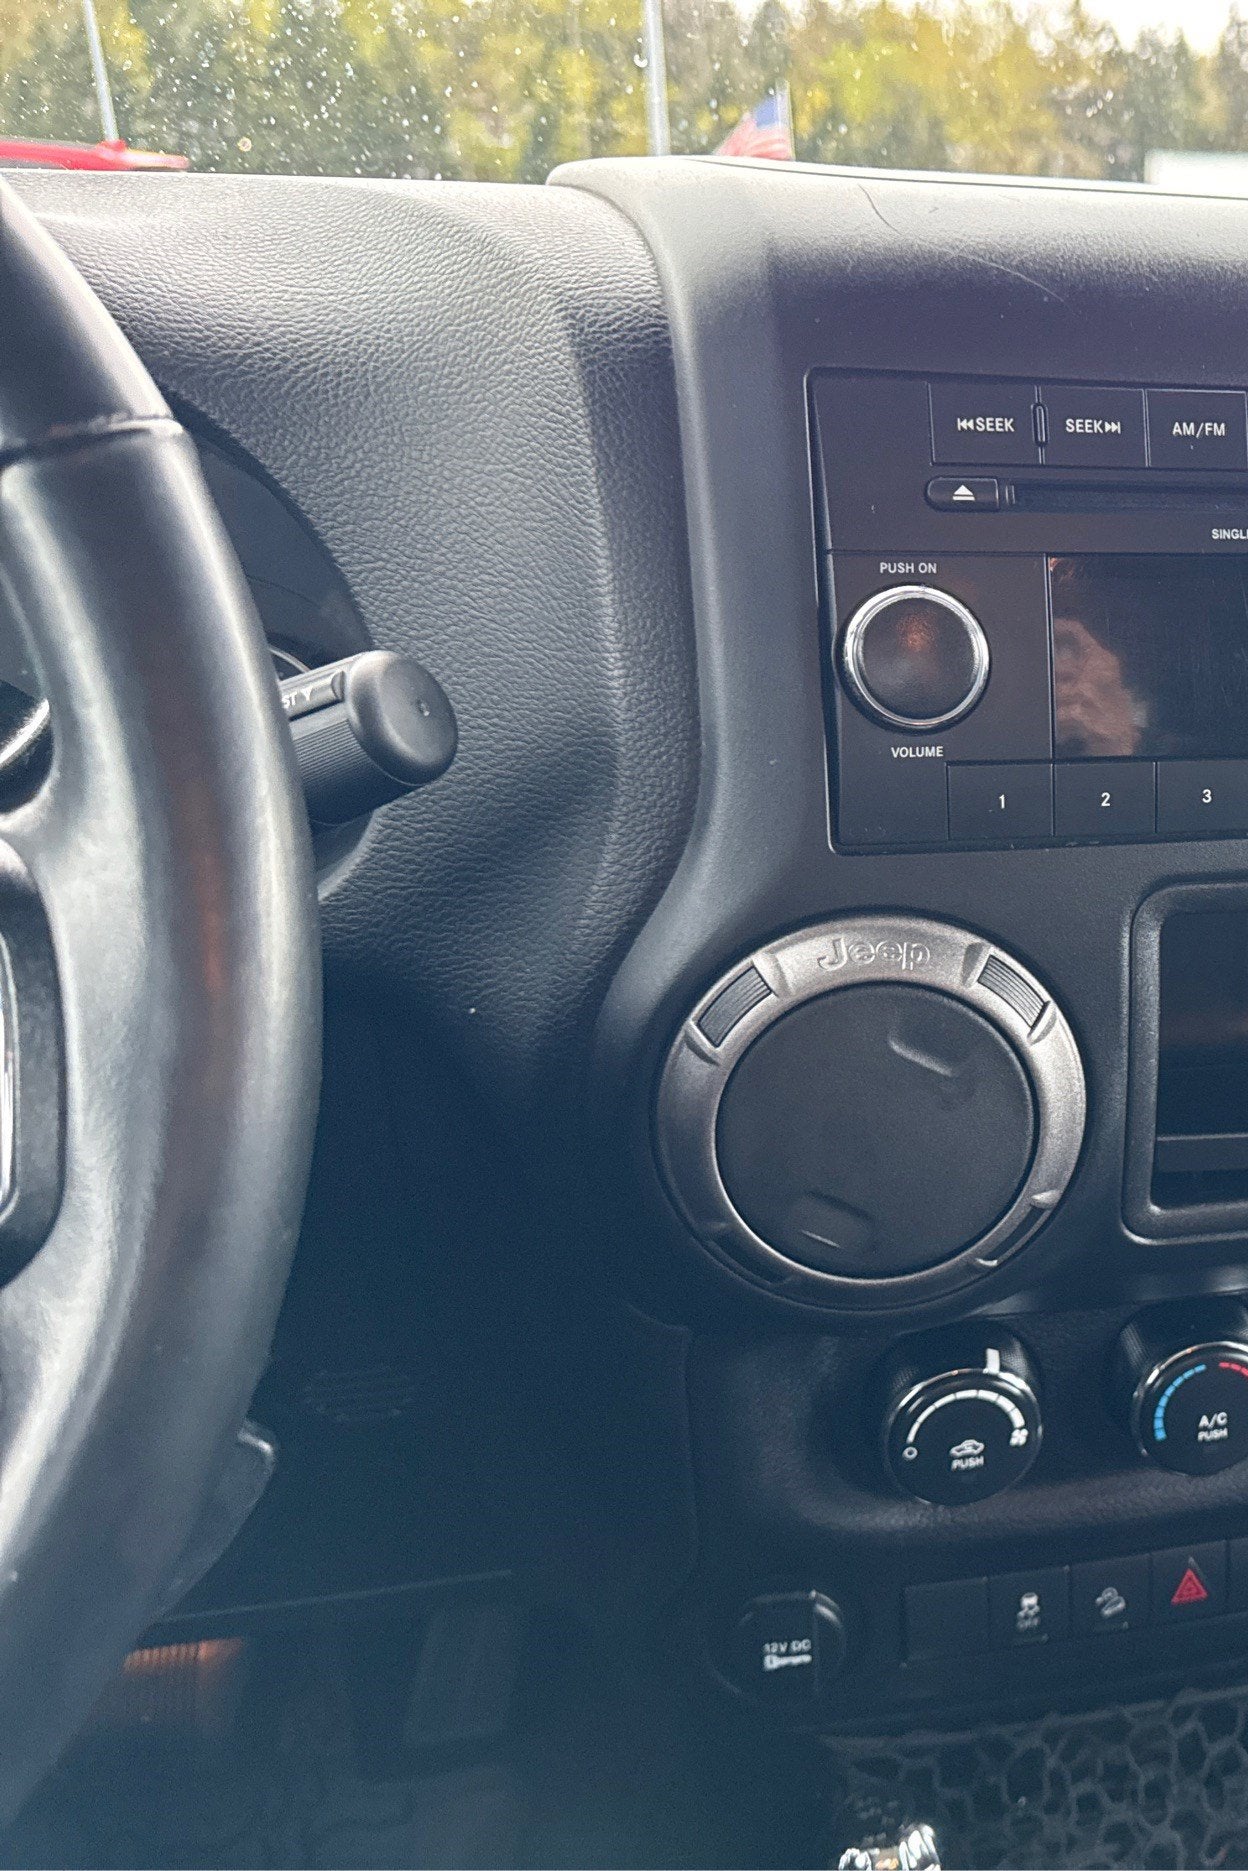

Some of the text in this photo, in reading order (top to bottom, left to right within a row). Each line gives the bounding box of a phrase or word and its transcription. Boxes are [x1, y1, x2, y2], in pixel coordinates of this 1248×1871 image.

[975, 416, 1015, 433] SEEK
[1065, 418, 1103, 434] SEEK
[1172, 421, 1226, 438] AM/FM
[879, 561, 938, 575] PUSH ON
[890, 745, 945, 759] VOLUME
[998, 794, 1006, 810] 1
[1101, 792, 1112, 807] 2
[1202, 788, 1213, 804] 3
[817, 937, 931, 972] Jeep
[1198, 1411, 1228, 1429] A/C
[1197, 1428, 1229, 1442] PUSH
[951, 1456, 985, 1472] PUSH
[763, 1641, 789, 1654] 12V
